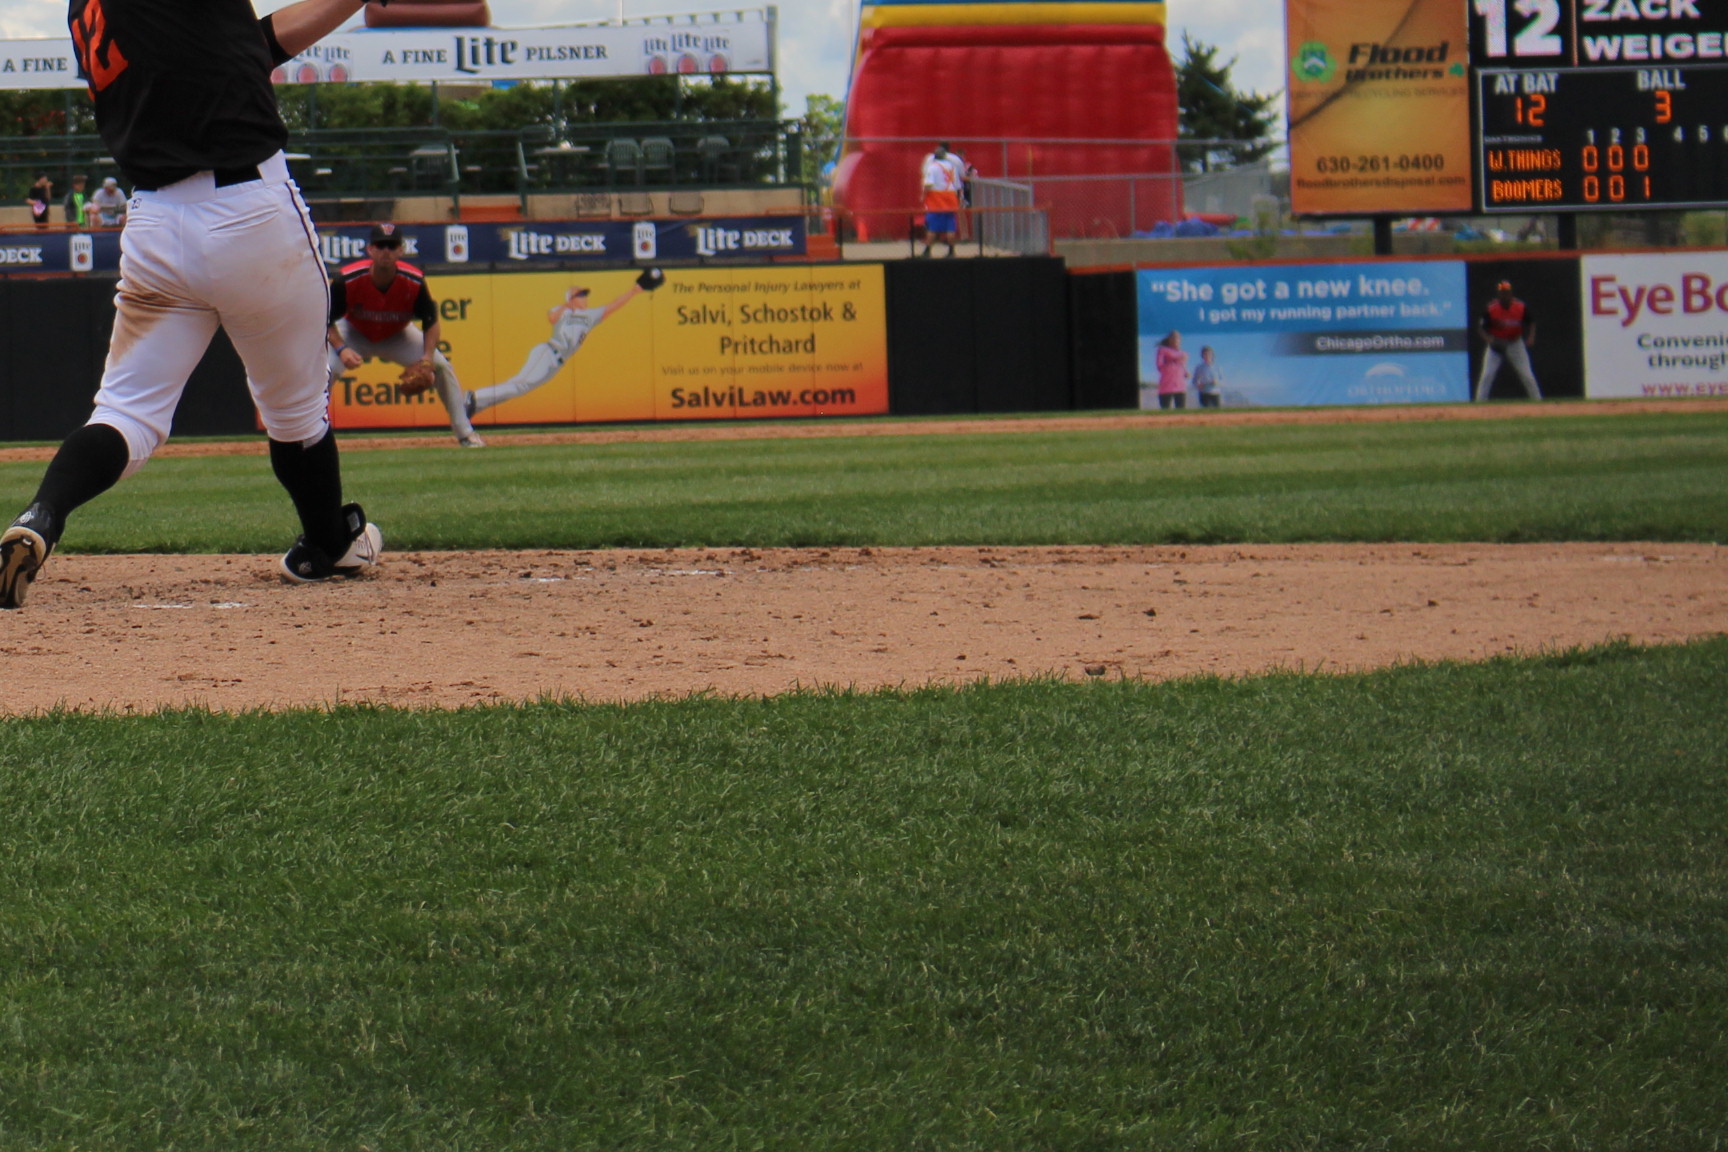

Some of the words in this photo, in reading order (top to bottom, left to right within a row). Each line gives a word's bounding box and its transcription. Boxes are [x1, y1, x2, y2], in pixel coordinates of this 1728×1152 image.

[671, 32, 702, 52] Lite
[1348, 42, 1449, 65] Flood
[2, 58, 16, 73] A
[23, 57, 68, 72] FINE
[382, 50, 396, 65] A
[402, 48, 448, 63] FINE
[454, 35, 518, 75] Lite
[525, 45, 609, 61] PILSNER
[1494, 73, 1518, 95] AT
[1523, 72, 1559, 94] BAT
[1637, 68, 1686, 91] BALL
[1515, 93, 1547, 127] 12
[1655, 90, 1671, 124] 3
[1611, 127, 1621, 144] 2
[1635, 127, 1646, 144] 3
[1673, 126, 1684, 142] 4
[1699, 125, 1709, 143] 5
[1316, 153, 1445, 173] 630-261-0400
[1488, 149, 1562, 171] W.THINGS
[1582, 145, 1599, 172] 0
[1608, 144, 1624, 171] 0
[1633, 143, 1650, 171] 0
[1491, 178, 1563, 203] BOOMERS
[1583, 174, 1600, 202] 0
[1609, 173, 1626, 201] 0
[1644, 175, 1651, 200] 1
[323, 234, 366, 264] Lite
[508, 230, 553, 260] Lite
[556, 234, 607, 252] DECK
[696, 227, 740, 257] Lite
[743, 230, 794, 248] DECK
[673, 283, 694, 294] The
[698, 280, 750, 293] Personal
[755, 280, 790, 294] Injury
[794, 279, 845, 293] Lawyers
[849, 280, 862, 290] at
[1221, 278, 1266, 305] got
[1274, 282, 1290, 299] a
[1297, 279, 1351, 298] new
[1358, 274, 1430, 297] knee.
[1209, 307, 1237, 324] got
[1242, 308, 1265, 323] my
[1270, 304, 1332, 321] running
[1336, 302, 1395, 320] partner
[1591, 274, 1675, 328] Eye
[677, 304, 733, 327] Salvi,
[740, 301, 834, 324] Schostok
[842, 301, 857, 322] &
[720, 333, 816, 355] Pritchard
[1315, 335, 1445, 352] ChicagoOrtho.com
[672, 385, 856, 409] SalviLaw.com
